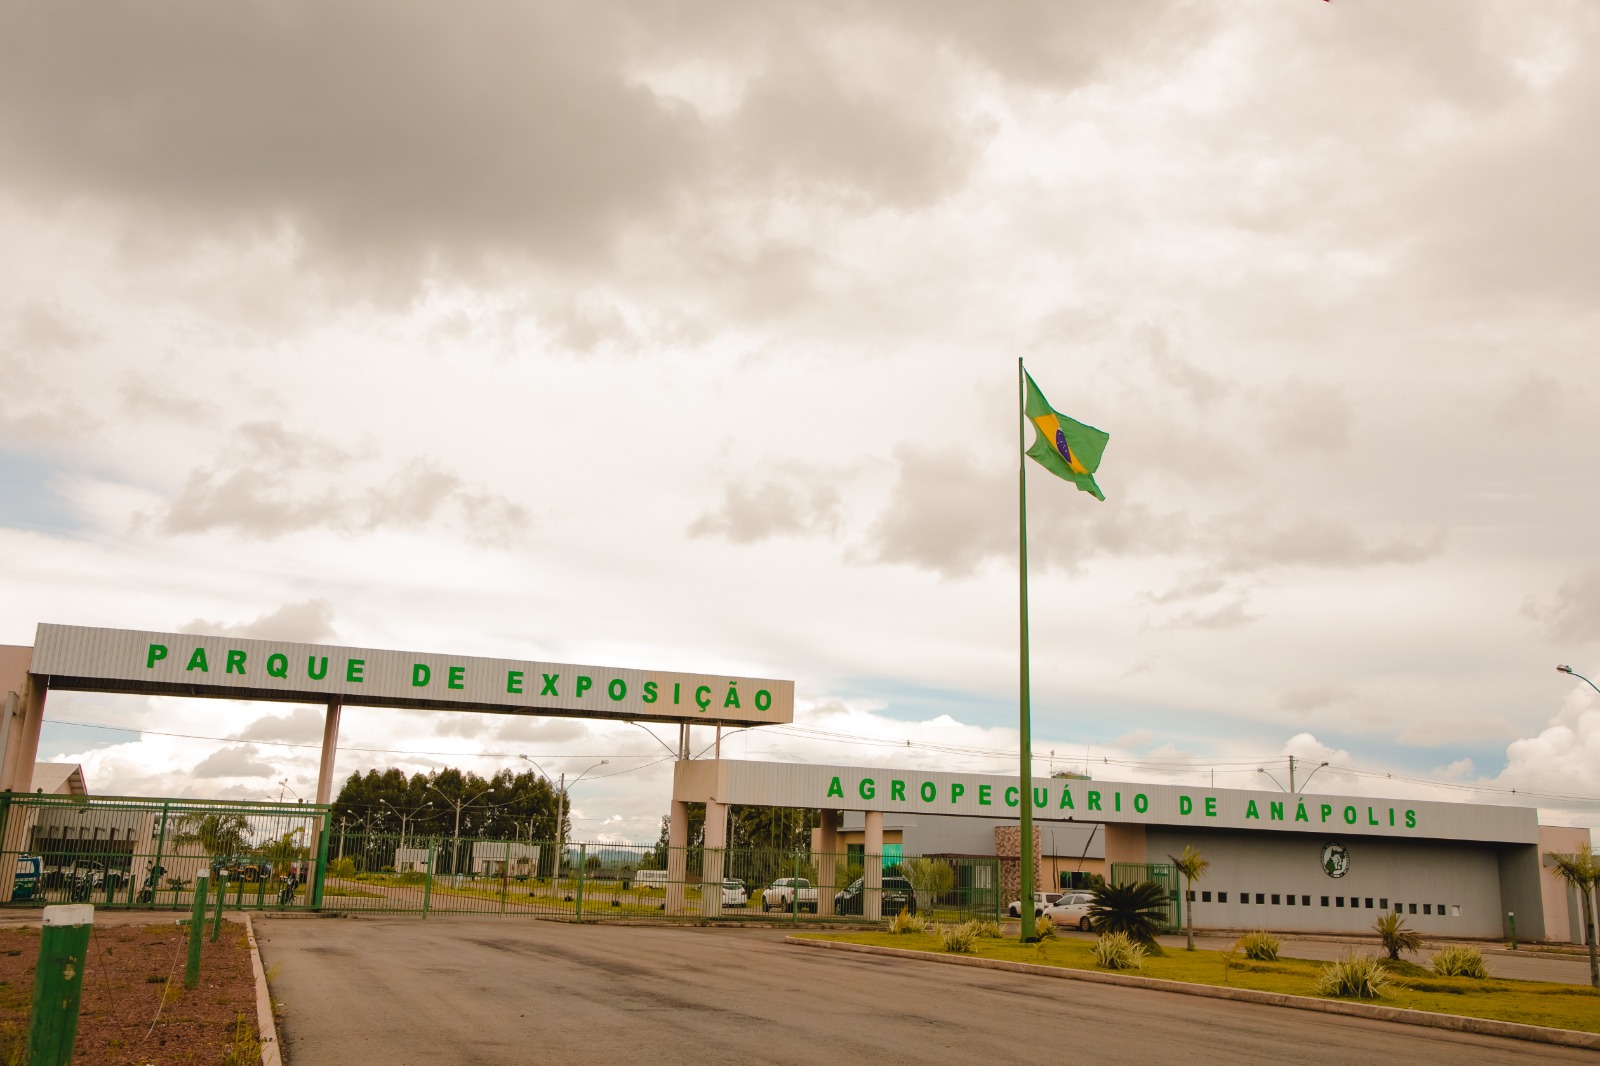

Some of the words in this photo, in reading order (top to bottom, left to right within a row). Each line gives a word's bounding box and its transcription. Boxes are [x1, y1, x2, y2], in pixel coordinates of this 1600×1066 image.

[146, 643, 366, 683] PARQUE
[411, 663, 466, 690] DE
[506, 670, 772, 713] EXPOSIÇÃO
[826, 776, 1149, 814] AGROPECUÁRIO
[1179, 795, 1217, 817] DE
[1245, 797, 1417, 829] ANÁPOLIS
